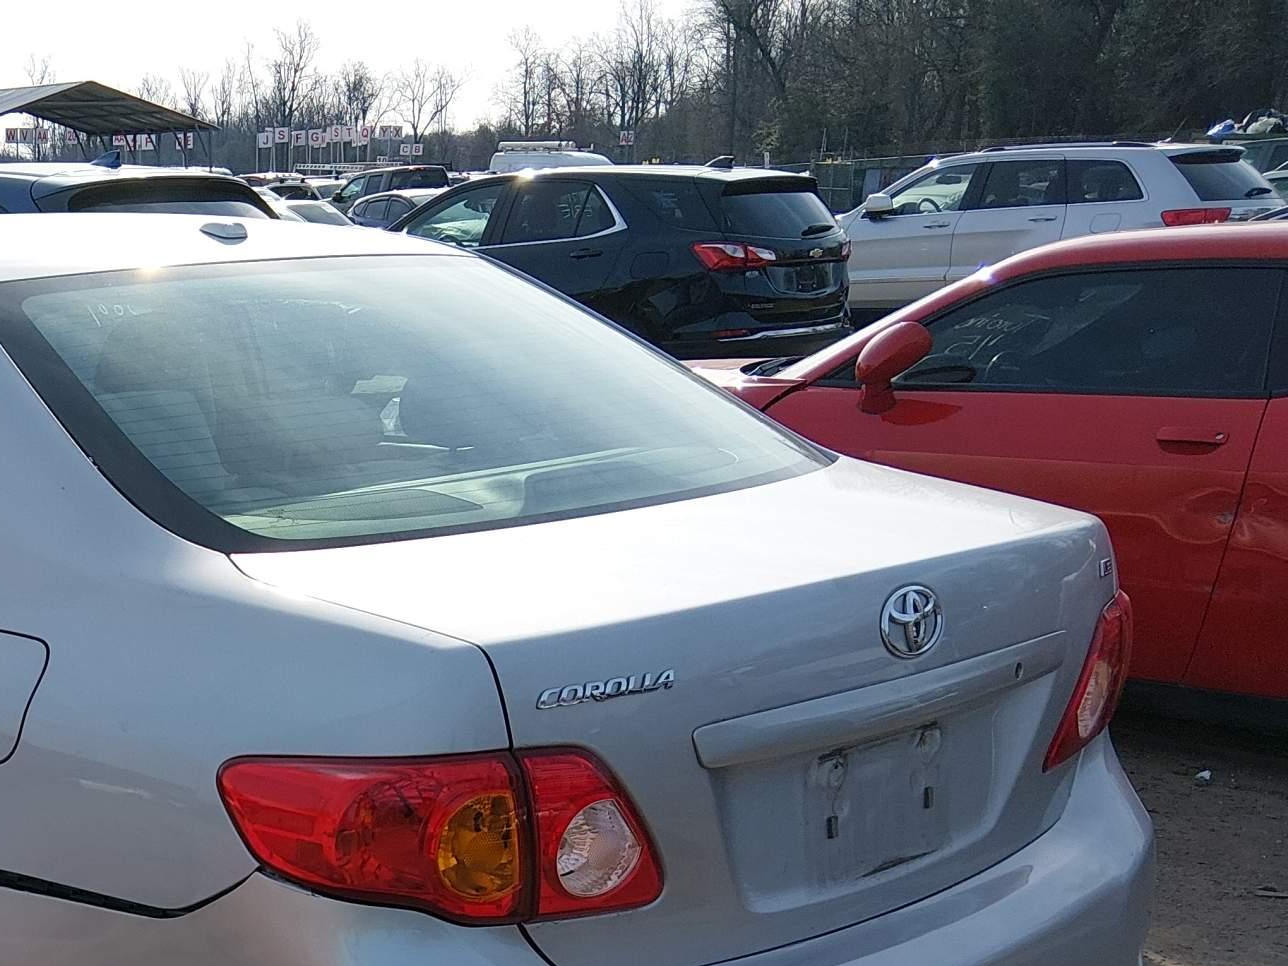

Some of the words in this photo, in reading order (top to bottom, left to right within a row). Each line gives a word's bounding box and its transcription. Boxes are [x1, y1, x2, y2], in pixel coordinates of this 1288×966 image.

[278, 130, 286, 141] S
[295, 133, 303, 144] F
[311, 132, 319, 143] G
[535, 668, 676, 710] COROLLA
